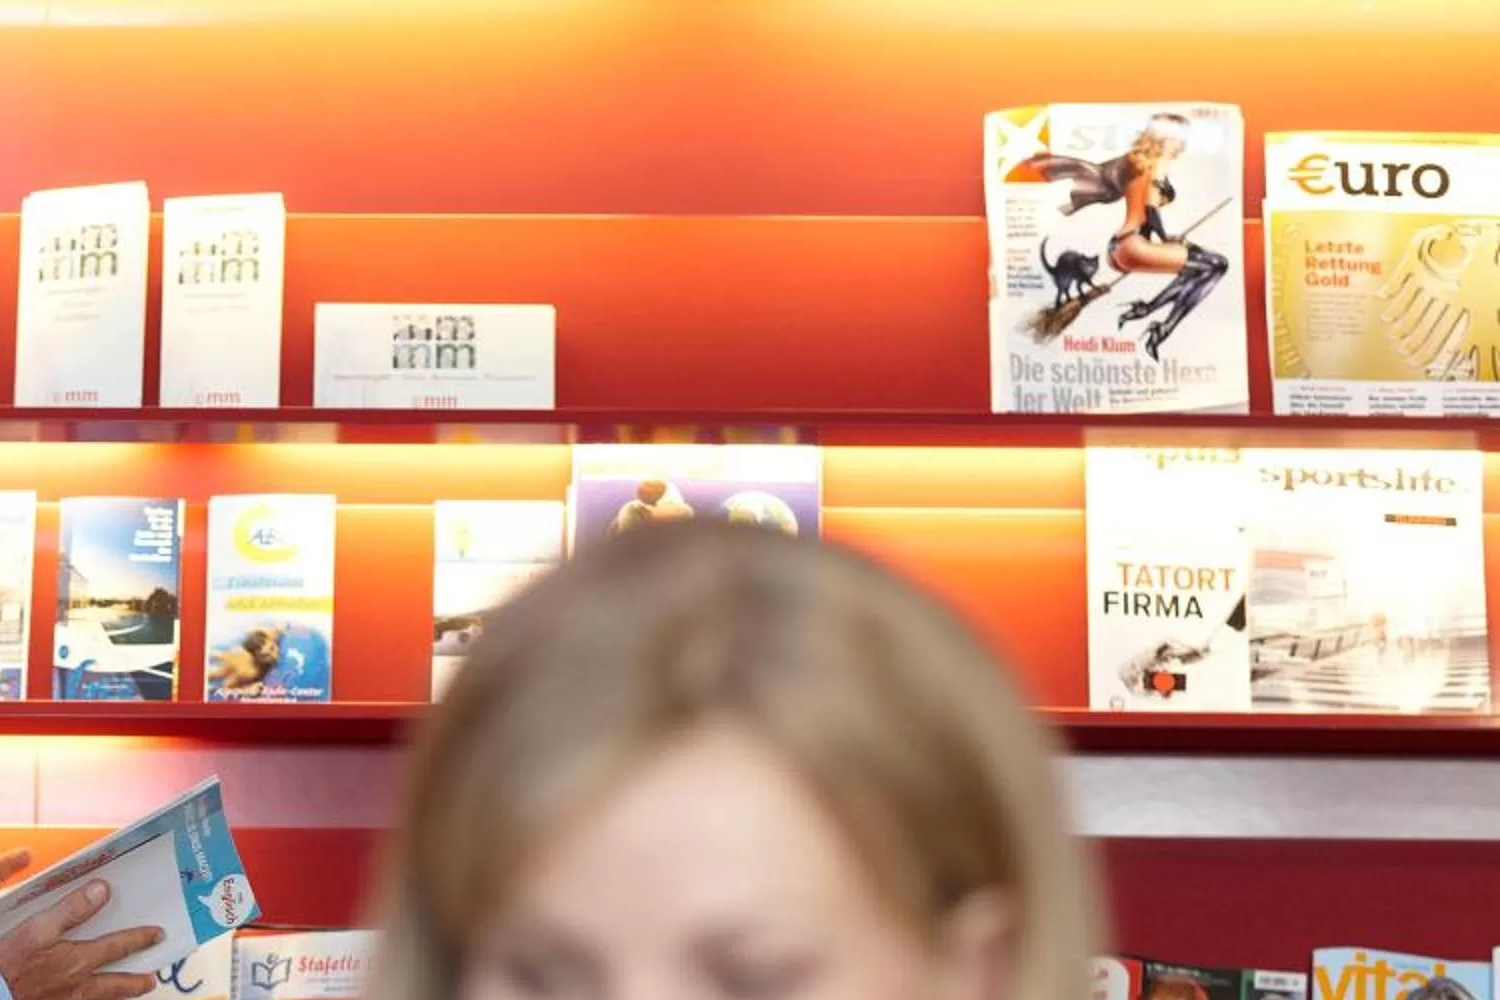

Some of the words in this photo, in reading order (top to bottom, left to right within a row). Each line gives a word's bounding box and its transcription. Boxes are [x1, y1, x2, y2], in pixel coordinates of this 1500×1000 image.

[1288, 153, 1450, 199] €uro
[1304, 239, 1365, 255] Letzte
[1304, 255, 1382, 275] Rettung
[1304, 272, 1350, 288] Gold
[1063, 335, 1098, 353] Heidi
[1101, 336, 1137, 353] Klum
[1009, 351, 1044, 383] Die
[1051, 355, 1157, 386] schönste
[1052, 387, 1102, 412] Welt
[1115, 561, 1237, 593] TATORT
[1102, 591, 1204, 619] FIRMA
